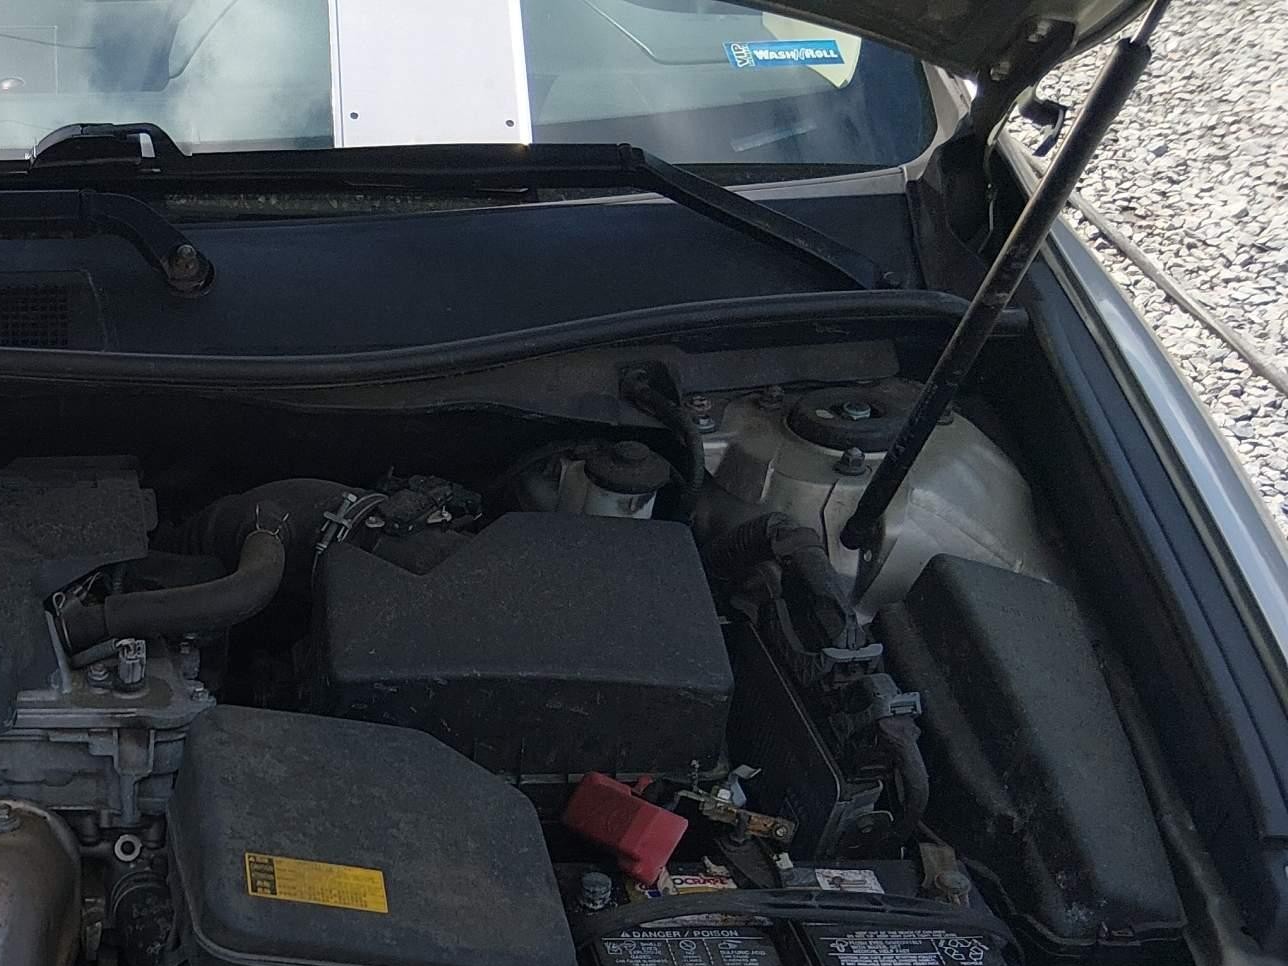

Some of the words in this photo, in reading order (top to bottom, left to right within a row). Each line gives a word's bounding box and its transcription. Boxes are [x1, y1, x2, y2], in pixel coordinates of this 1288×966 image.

[731, 43, 749, 68] VIP
[805, 48, 839, 59] ROLL
[632, 930, 681, 938] DANGER
[693, 930, 738, 938] POISON
